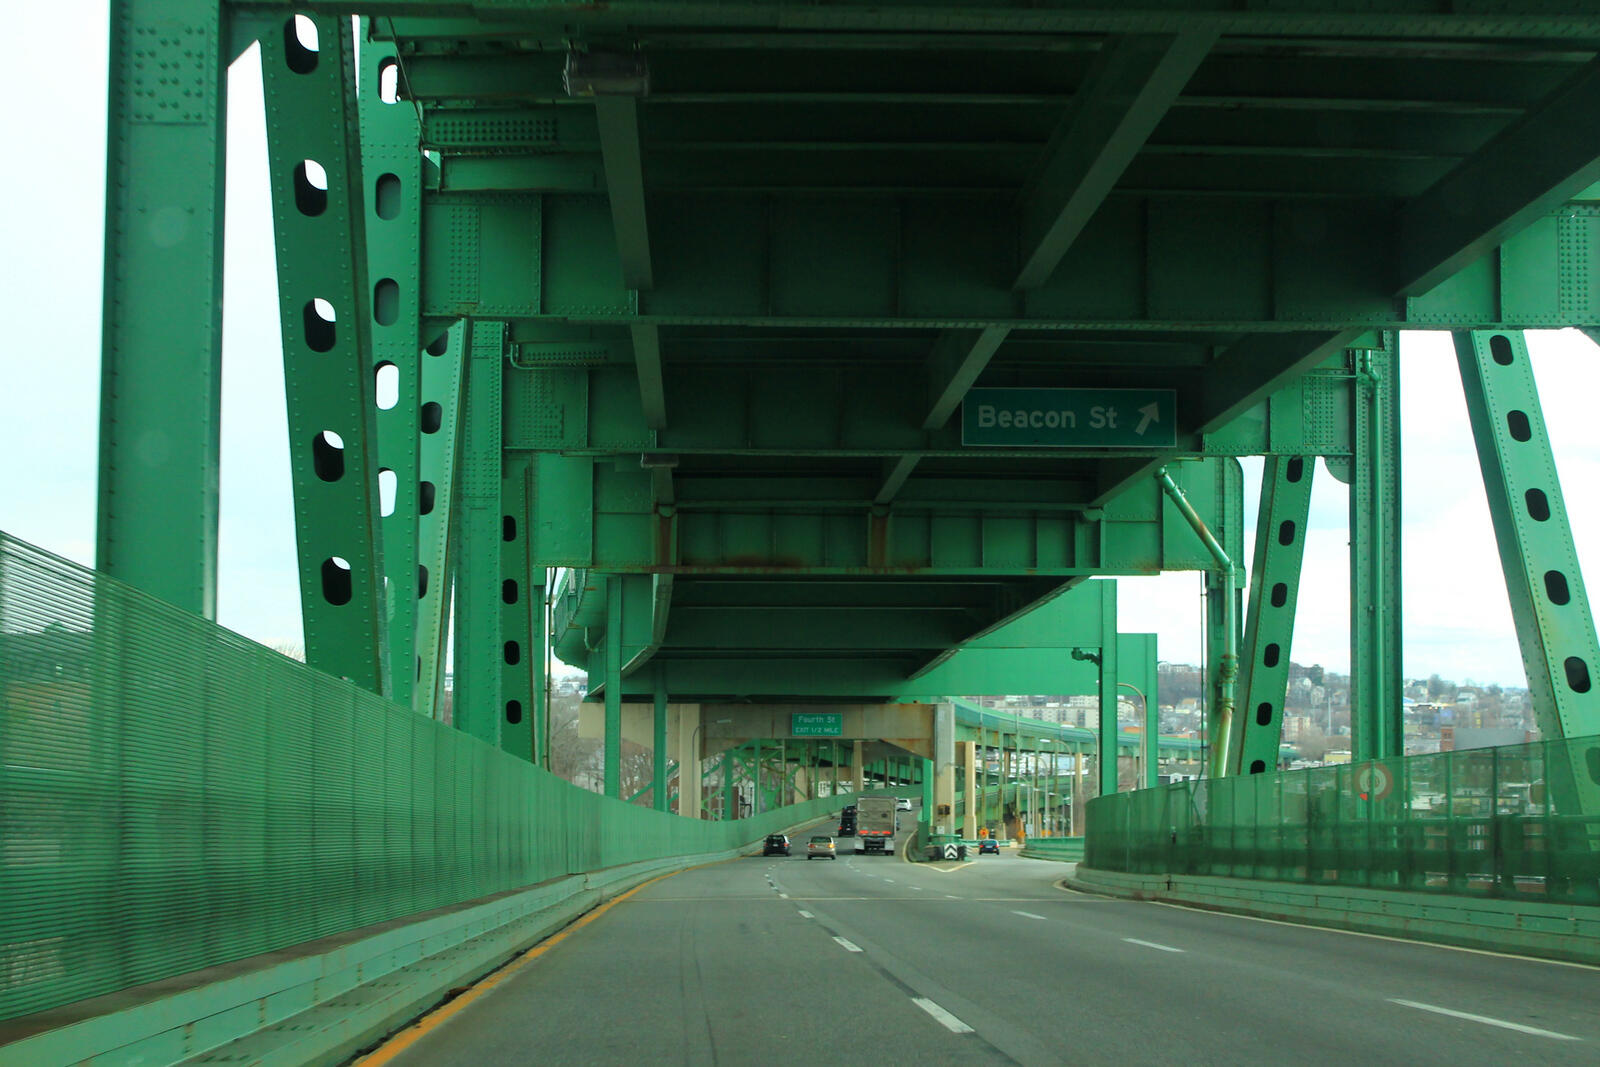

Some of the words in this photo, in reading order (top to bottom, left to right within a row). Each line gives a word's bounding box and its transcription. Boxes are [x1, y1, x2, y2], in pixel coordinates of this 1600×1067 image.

[978, 404, 1076, 429] Beacon
[1089, 405, 1117, 429] St
[798, 715, 824, 723] Fourth
[827, 715, 836, 723] St
